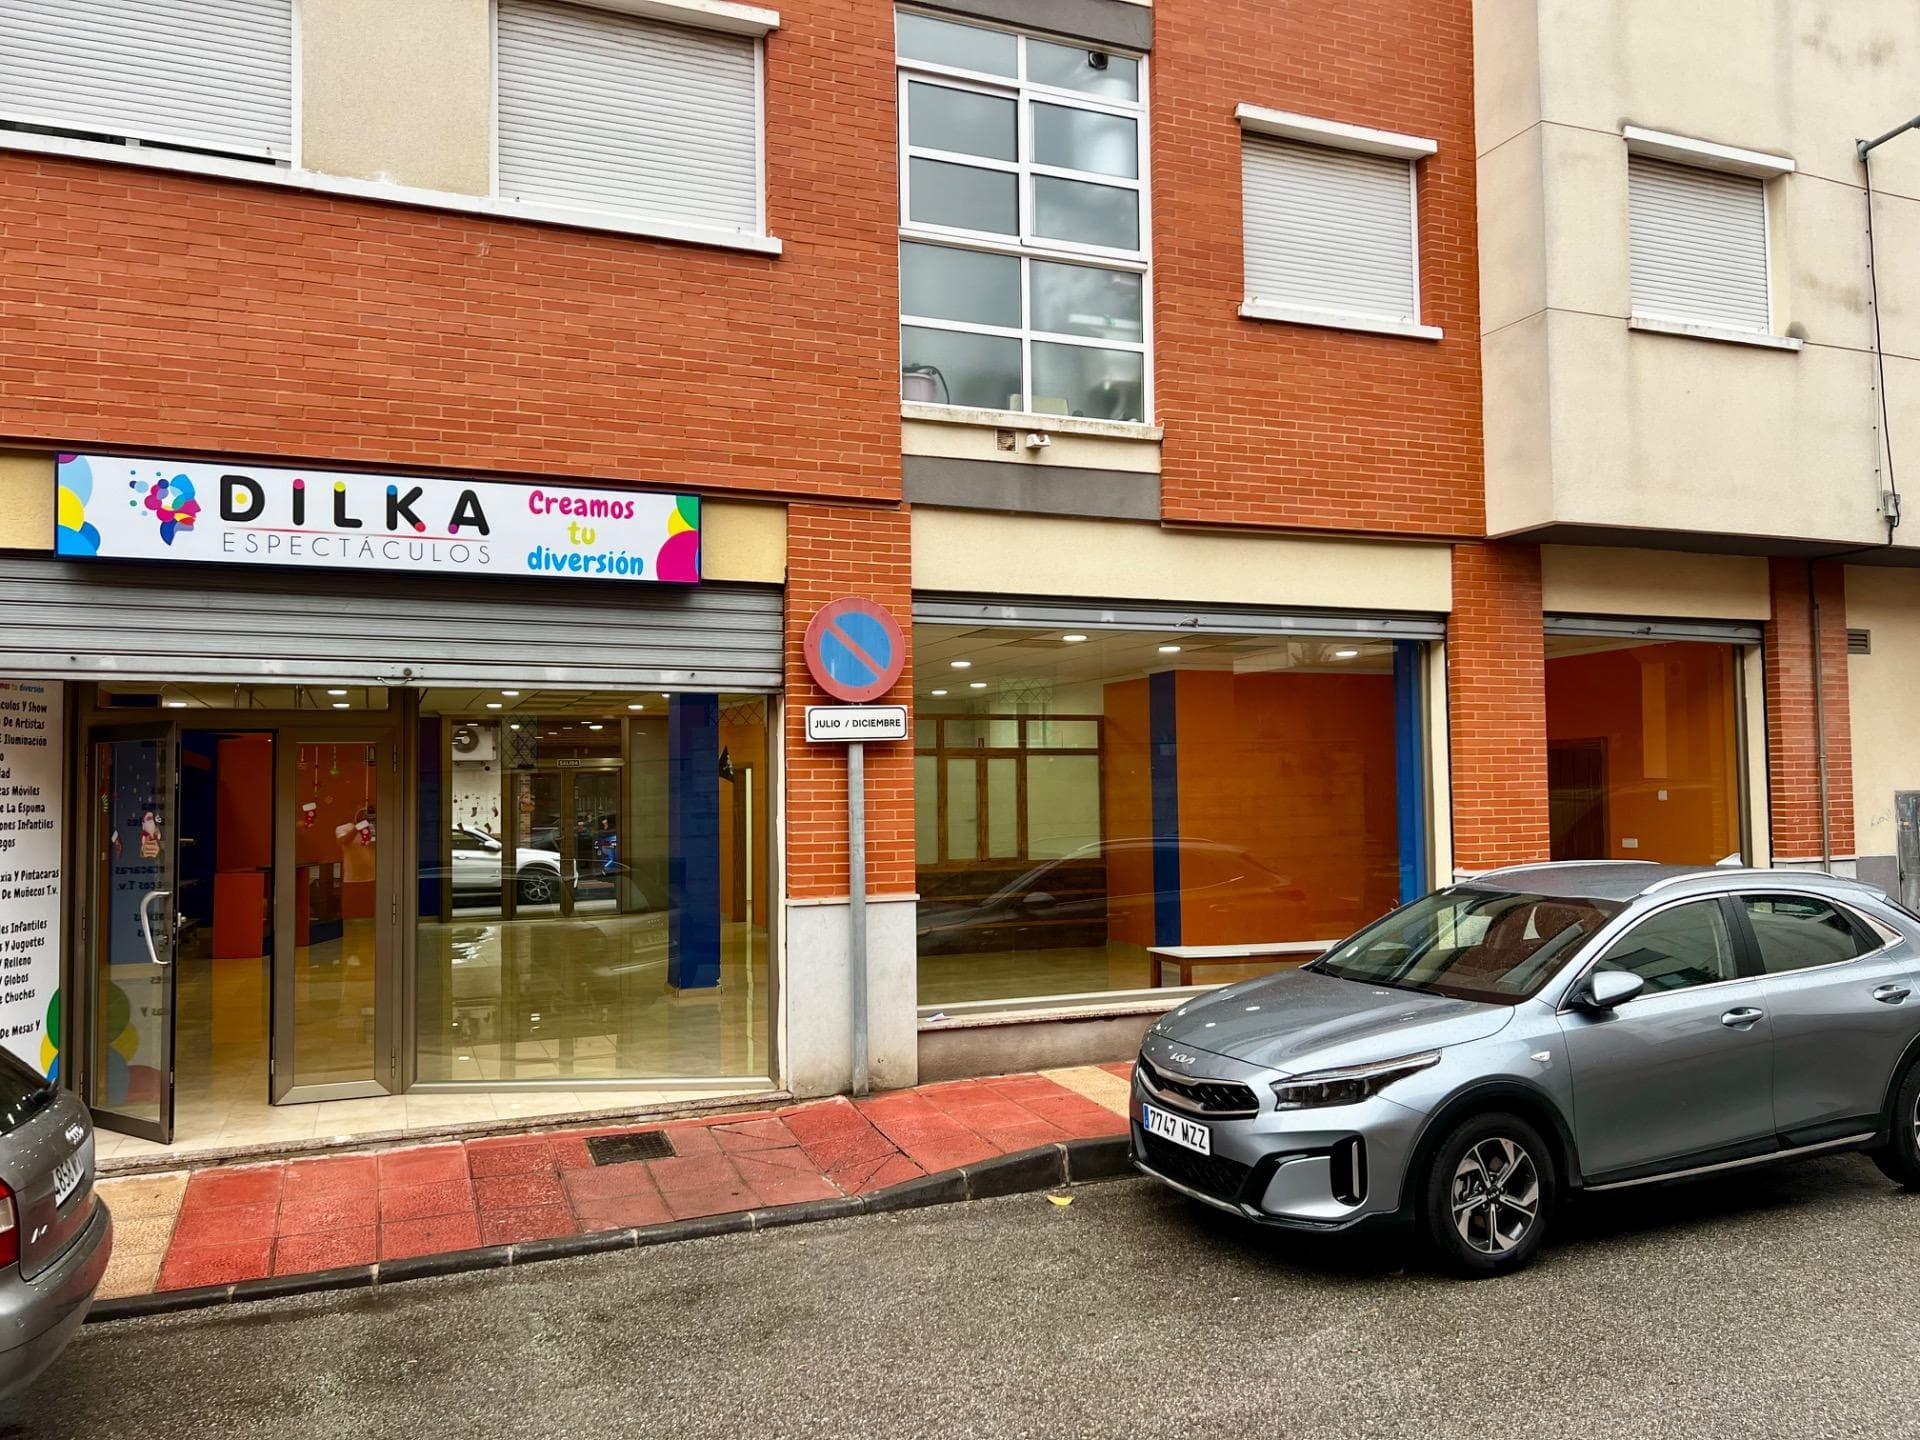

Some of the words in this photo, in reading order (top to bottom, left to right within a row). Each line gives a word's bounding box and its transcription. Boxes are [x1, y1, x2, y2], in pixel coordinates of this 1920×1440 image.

[220, 474, 490, 536] DILKA
[528, 490, 634, 519] Creamos
[567, 521, 596, 545] tu
[223, 532, 491, 564] ESPECTÁCULOS
[527, 545, 644, 576] diversión
[28, 701, 48, 713] Show
[4, 716, 13, 727] De
[16, 718, 45, 730] Artistas
[815, 719, 841, 729] JULIO
[852, 718, 901, 728] DICIEMBRE
[12, 785, 40, 796] Móviles
[7, 803, 16, 813] La
[18, 802, 46, 816] Espuma
[18, 819, 54, 831] Infantiles
[14, 870, 19, 882] Y
[21, 869, 59, 881] Pintacaras
[2, 888, 11, 899] De
[14, 886, 45, 898] Muñecos
[11, 919, 47, 934] Infantiles
[11, 937, 45, 953] Juguetes
[4, 956, 31, 969] Relleno
[4, 973, 29, 986] Globos
[5, 989, 35, 1004] Chuches
[12, 1023, 34, 1037] Mesas
[1150, 1109, 1177, 1137] 7747
[1181, 1121, 1207, 1150] MZZ
